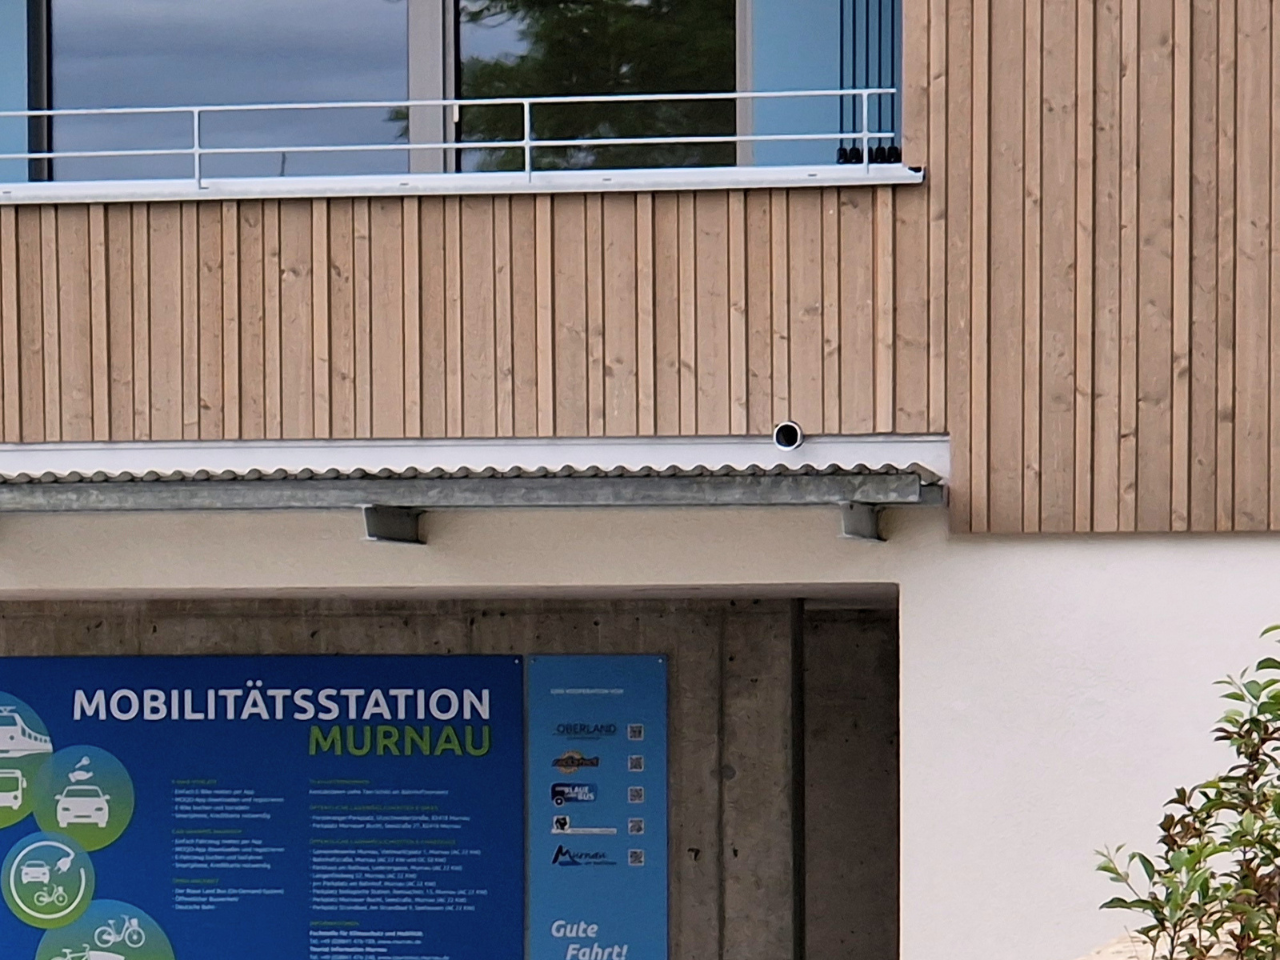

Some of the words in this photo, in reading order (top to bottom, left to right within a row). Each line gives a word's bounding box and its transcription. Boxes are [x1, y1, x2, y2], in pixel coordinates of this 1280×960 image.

[73, 679, 490, 721] MOBILITÄTSSTATION
[308, 725, 491, 757] MURNAU
[556, 723, 617, 734] OBERLAND
[551, 920, 598, 938] Gute
